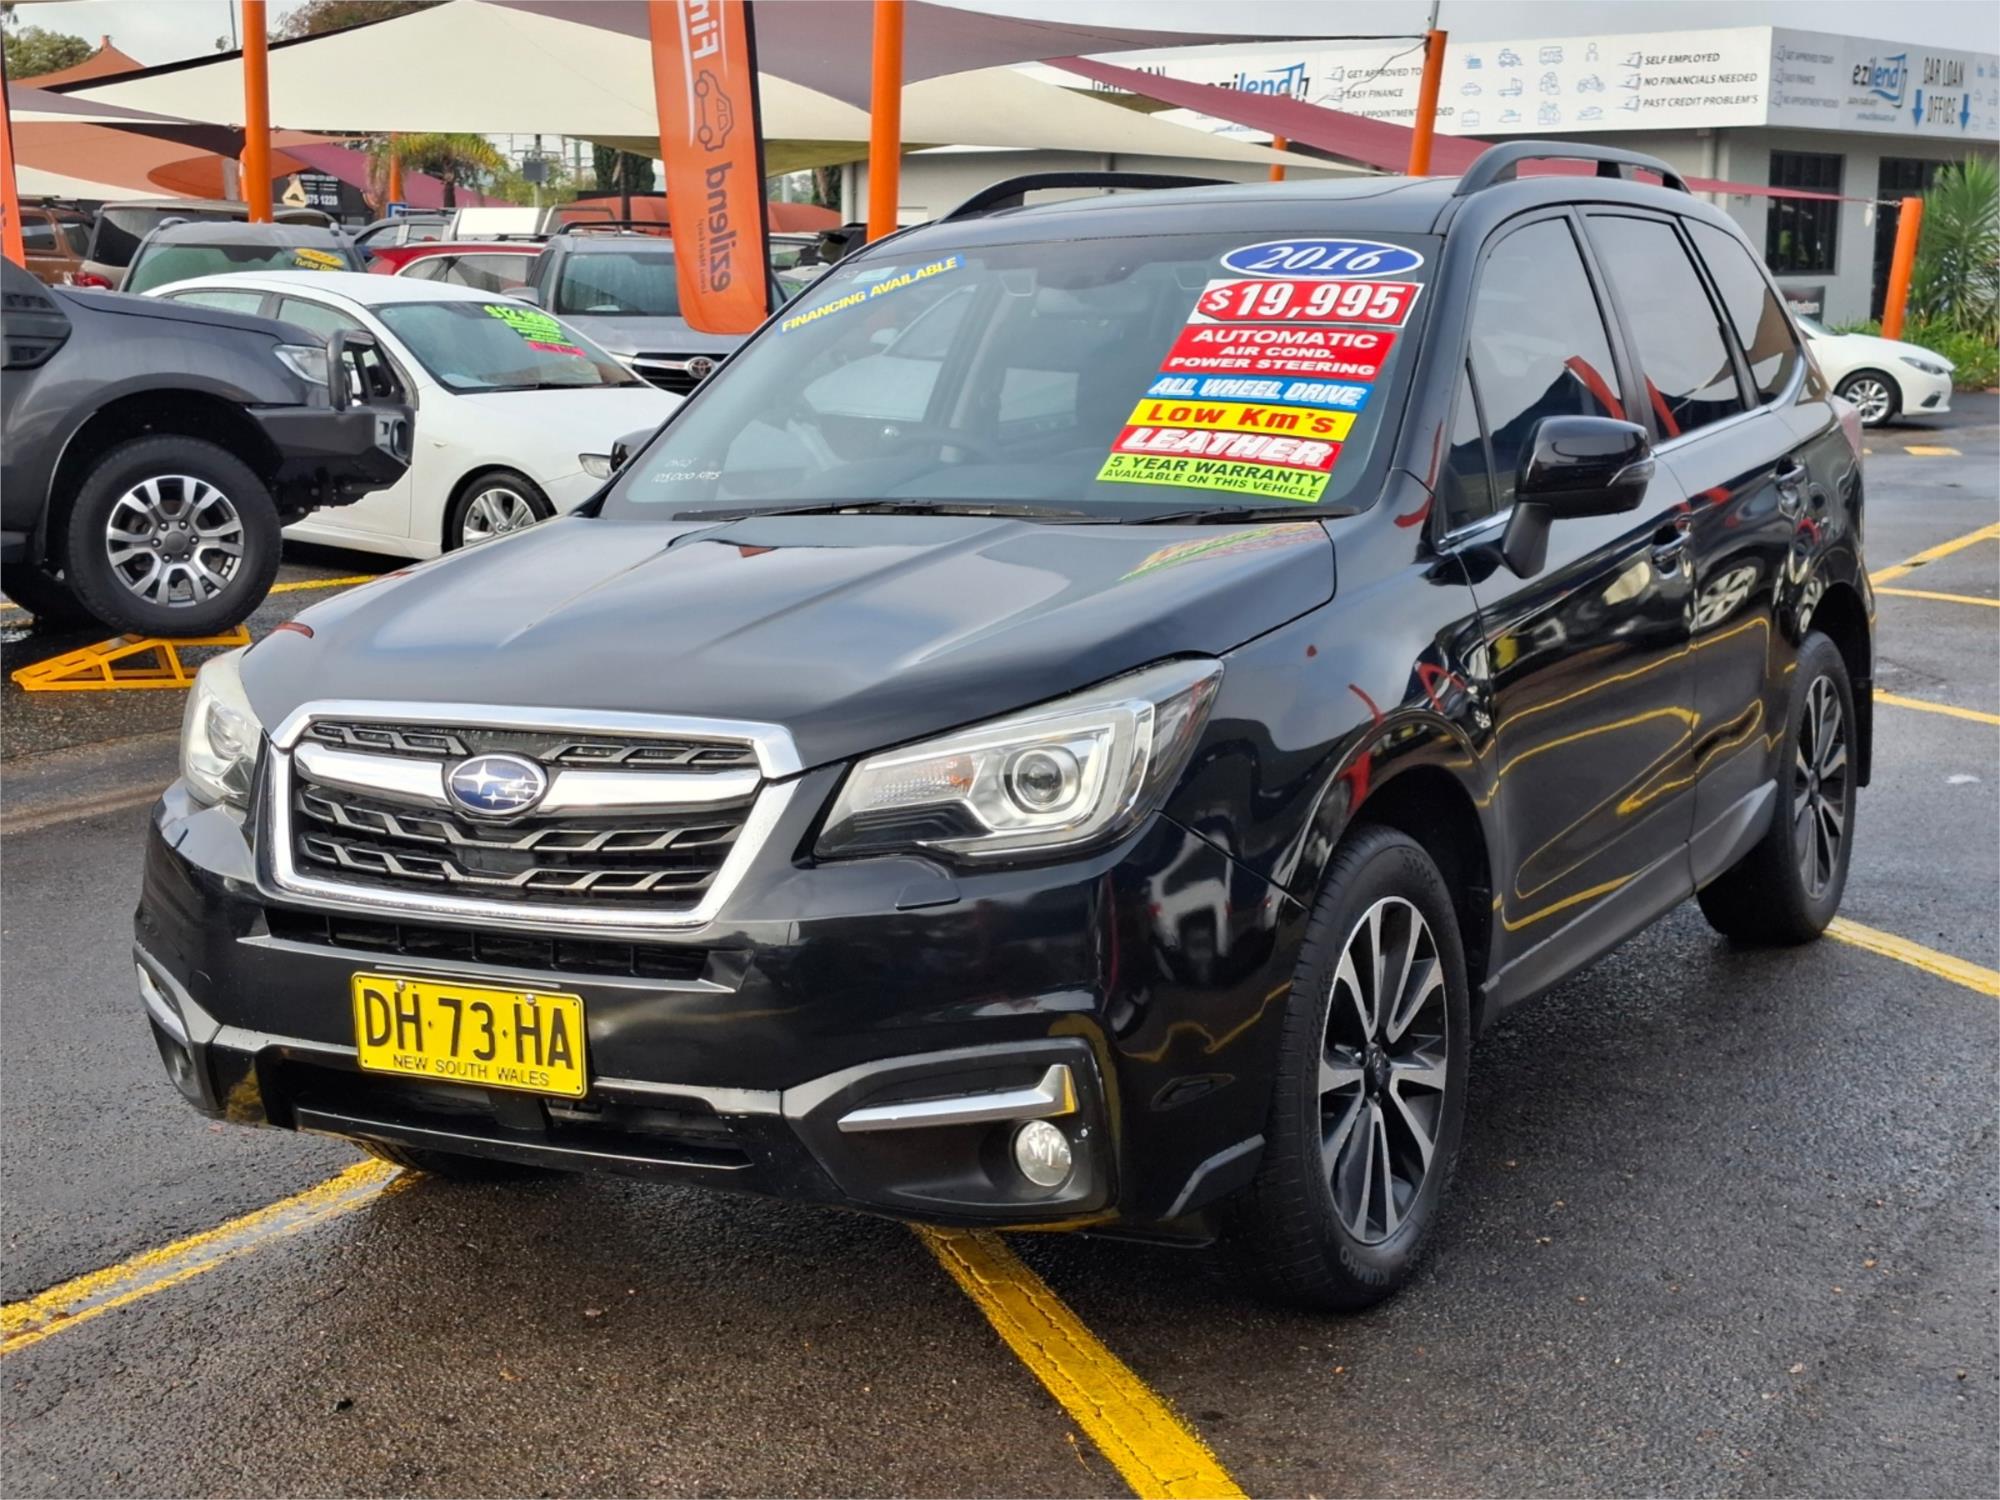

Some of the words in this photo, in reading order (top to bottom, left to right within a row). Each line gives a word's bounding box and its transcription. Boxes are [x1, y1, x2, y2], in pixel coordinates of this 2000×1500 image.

[1644, 55, 1667, 65] SELF
[1668, 53, 1720, 64] EMPLOYED
[1923, 56, 1941, 86] CAR
[1942, 59, 1965, 88] LOAN
[1346, 69, 1364, 79] GET
[1364, 67, 1409, 78] APPROVED
[1644, 77, 1659, 86] NO
[1660, 75, 1716, 86] FINANCIALS
[1718, 73, 1758, 83] NEEDED
[1346, 89, 1367, 99] EASY
[1368, 88, 1404, 98] FINANCE
[1643, 97, 1666, 107] PAST
[1667, 96, 1702, 107] CREDIT
[1703, 95, 1759, 106] PROBLEM'S
[1926, 95, 1956, 125] OFFICE
[1245, 246, 1398, 271] 2016
[781, 291, 867, 333] FINANCING
[869, 256, 957, 298] AVAILABLE
[1205, 282, 1406, 319] $19,995
[1191, 329, 1379, 349] AUTOMATIC
[1219, 346, 1261, 356] AIR
[1265, 346, 1336, 359] COND.
[1168, 357, 1251, 369] POWER
[1255, 359, 1376, 376] STEERING
[1147, 377, 1199, 396] ALL
[1199, 378, 1284, 400] WHEEL
[1283, 381, 1368, 407] DRIVE
[1237, 407, 1337, 433] Km's
[1121, 427, 1335, 468] LEATHER
[1103, 469, 1183, 482] AVAILABLE
[1186, 474, 1209, 484] ON
[1213, 476, 1253, 489] THIS
[1252, 481, 1319, 499] VEHICLE
[1110, 456, 1123, 468] 5
[1125, 457, 1189, 472] YEAR
[1193, 461, 1326, 487] WARRANTY
[392, 1054, 429, 1070] NEW
[434, 1059, 488, 1079] SOUTH
[496, 1066, 550, 1087] WALES
